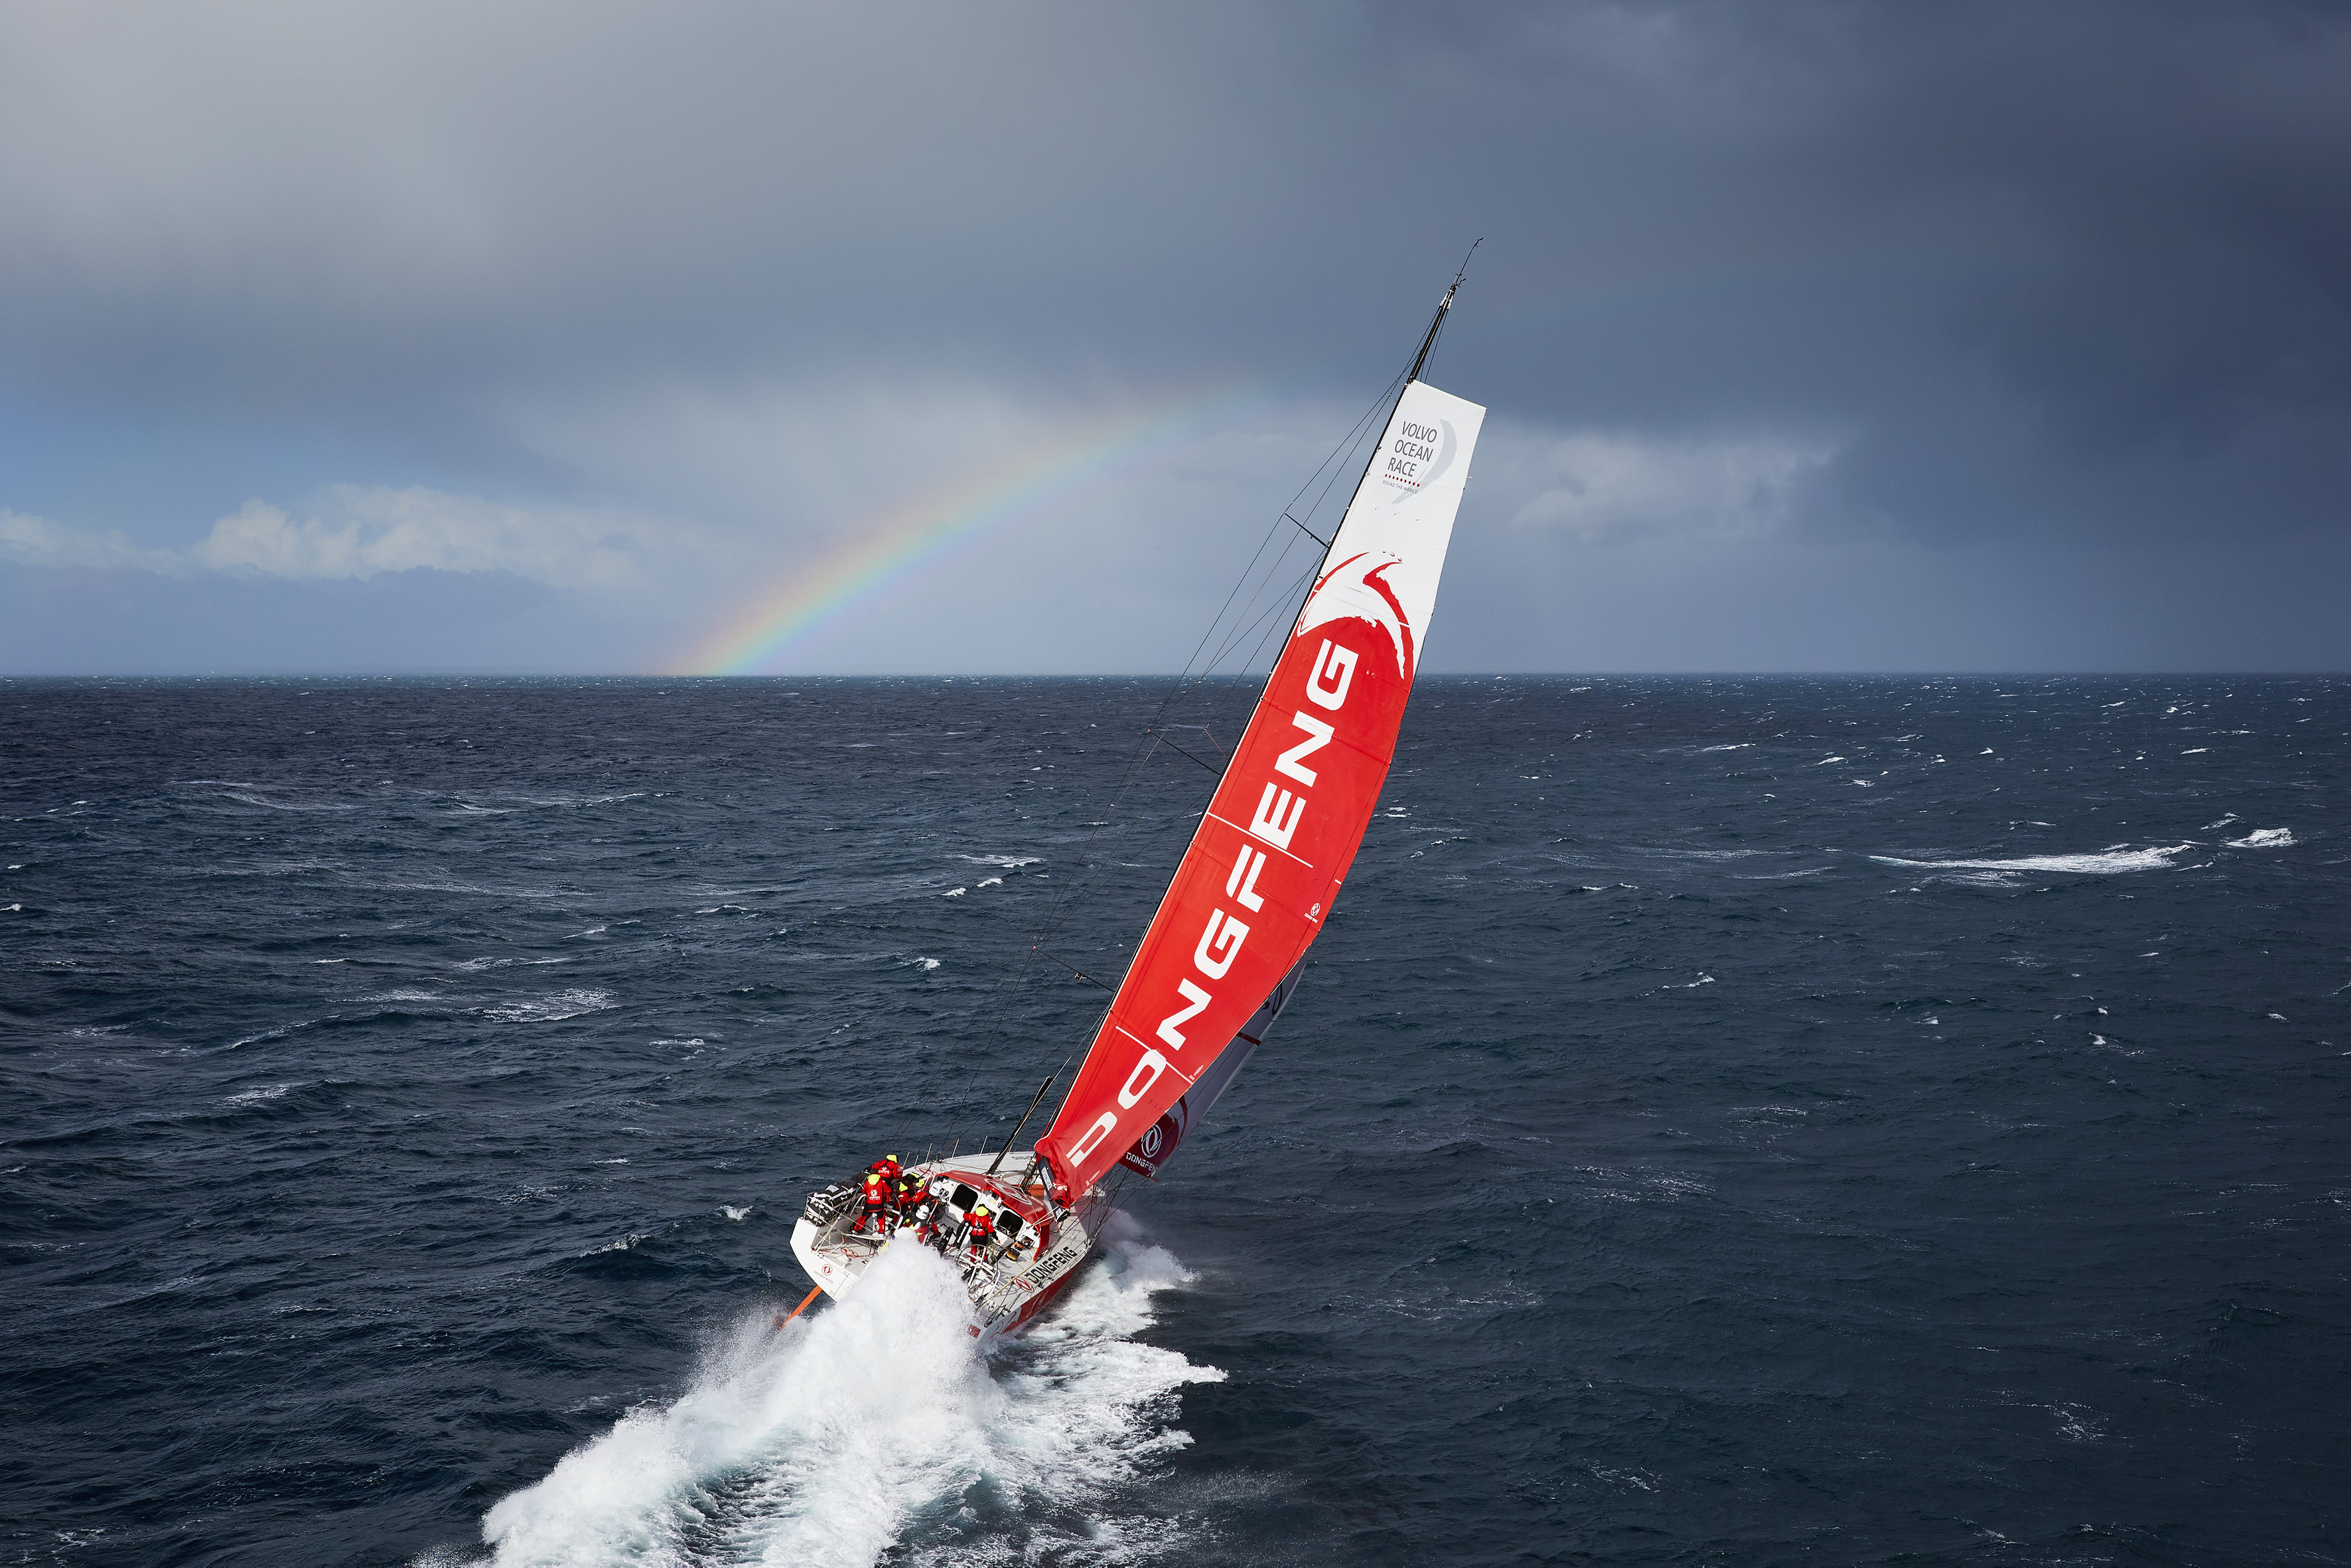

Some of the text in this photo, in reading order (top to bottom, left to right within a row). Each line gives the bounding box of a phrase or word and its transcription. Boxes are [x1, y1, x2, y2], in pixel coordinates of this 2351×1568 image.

[1402, 421, 1437, 443] VOLVO
[1394, 439, 1433, 462] OCEAN
[1388, 457, 1417, 477] RACE
[1403, 485, 1418, 494] WORLD
[1066, 638, 1359, 1168] DONGFENG
[1125, 1152, 1159, 1172] DONGFEN
[1024, 1246, 1078, 1284] DONGFENG
